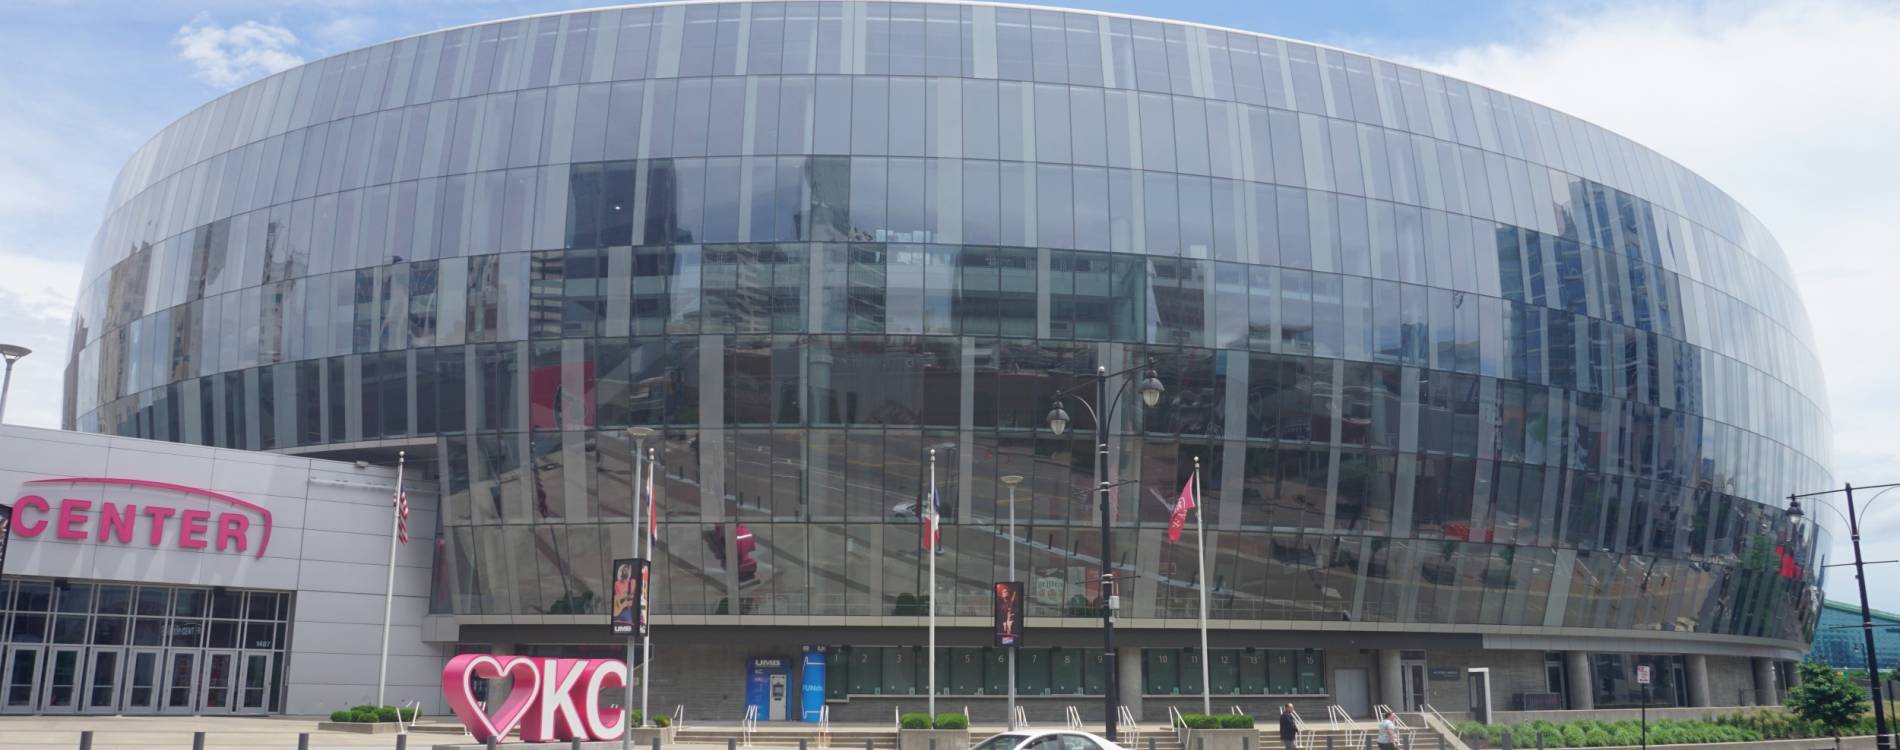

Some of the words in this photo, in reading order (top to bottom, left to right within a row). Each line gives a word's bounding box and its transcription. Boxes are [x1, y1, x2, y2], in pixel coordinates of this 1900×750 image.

[11, 495, 250, 553] CENTER
[861, 653, 868, 663] 2
[896, 653, 902, 663] 3
[965, 654, 970, 663] 5
[998, 655, 1004, 663] 6
[1032, 655, 1038, 664] 7
[1064, 655, 1070, 664] 8
[1097, 655, 1103, 664] 9
[1159, 655, 1168, 664] 10
[1191, 655, 1198, 664] 11
[1220, 656, 1229, 664] 12
[1250, 655, 1258, 664] 13
[1278, 655, 1286, 664] 14
[1306, 656, 1314, 665] 15
[540, 659, 628, 740] KC
